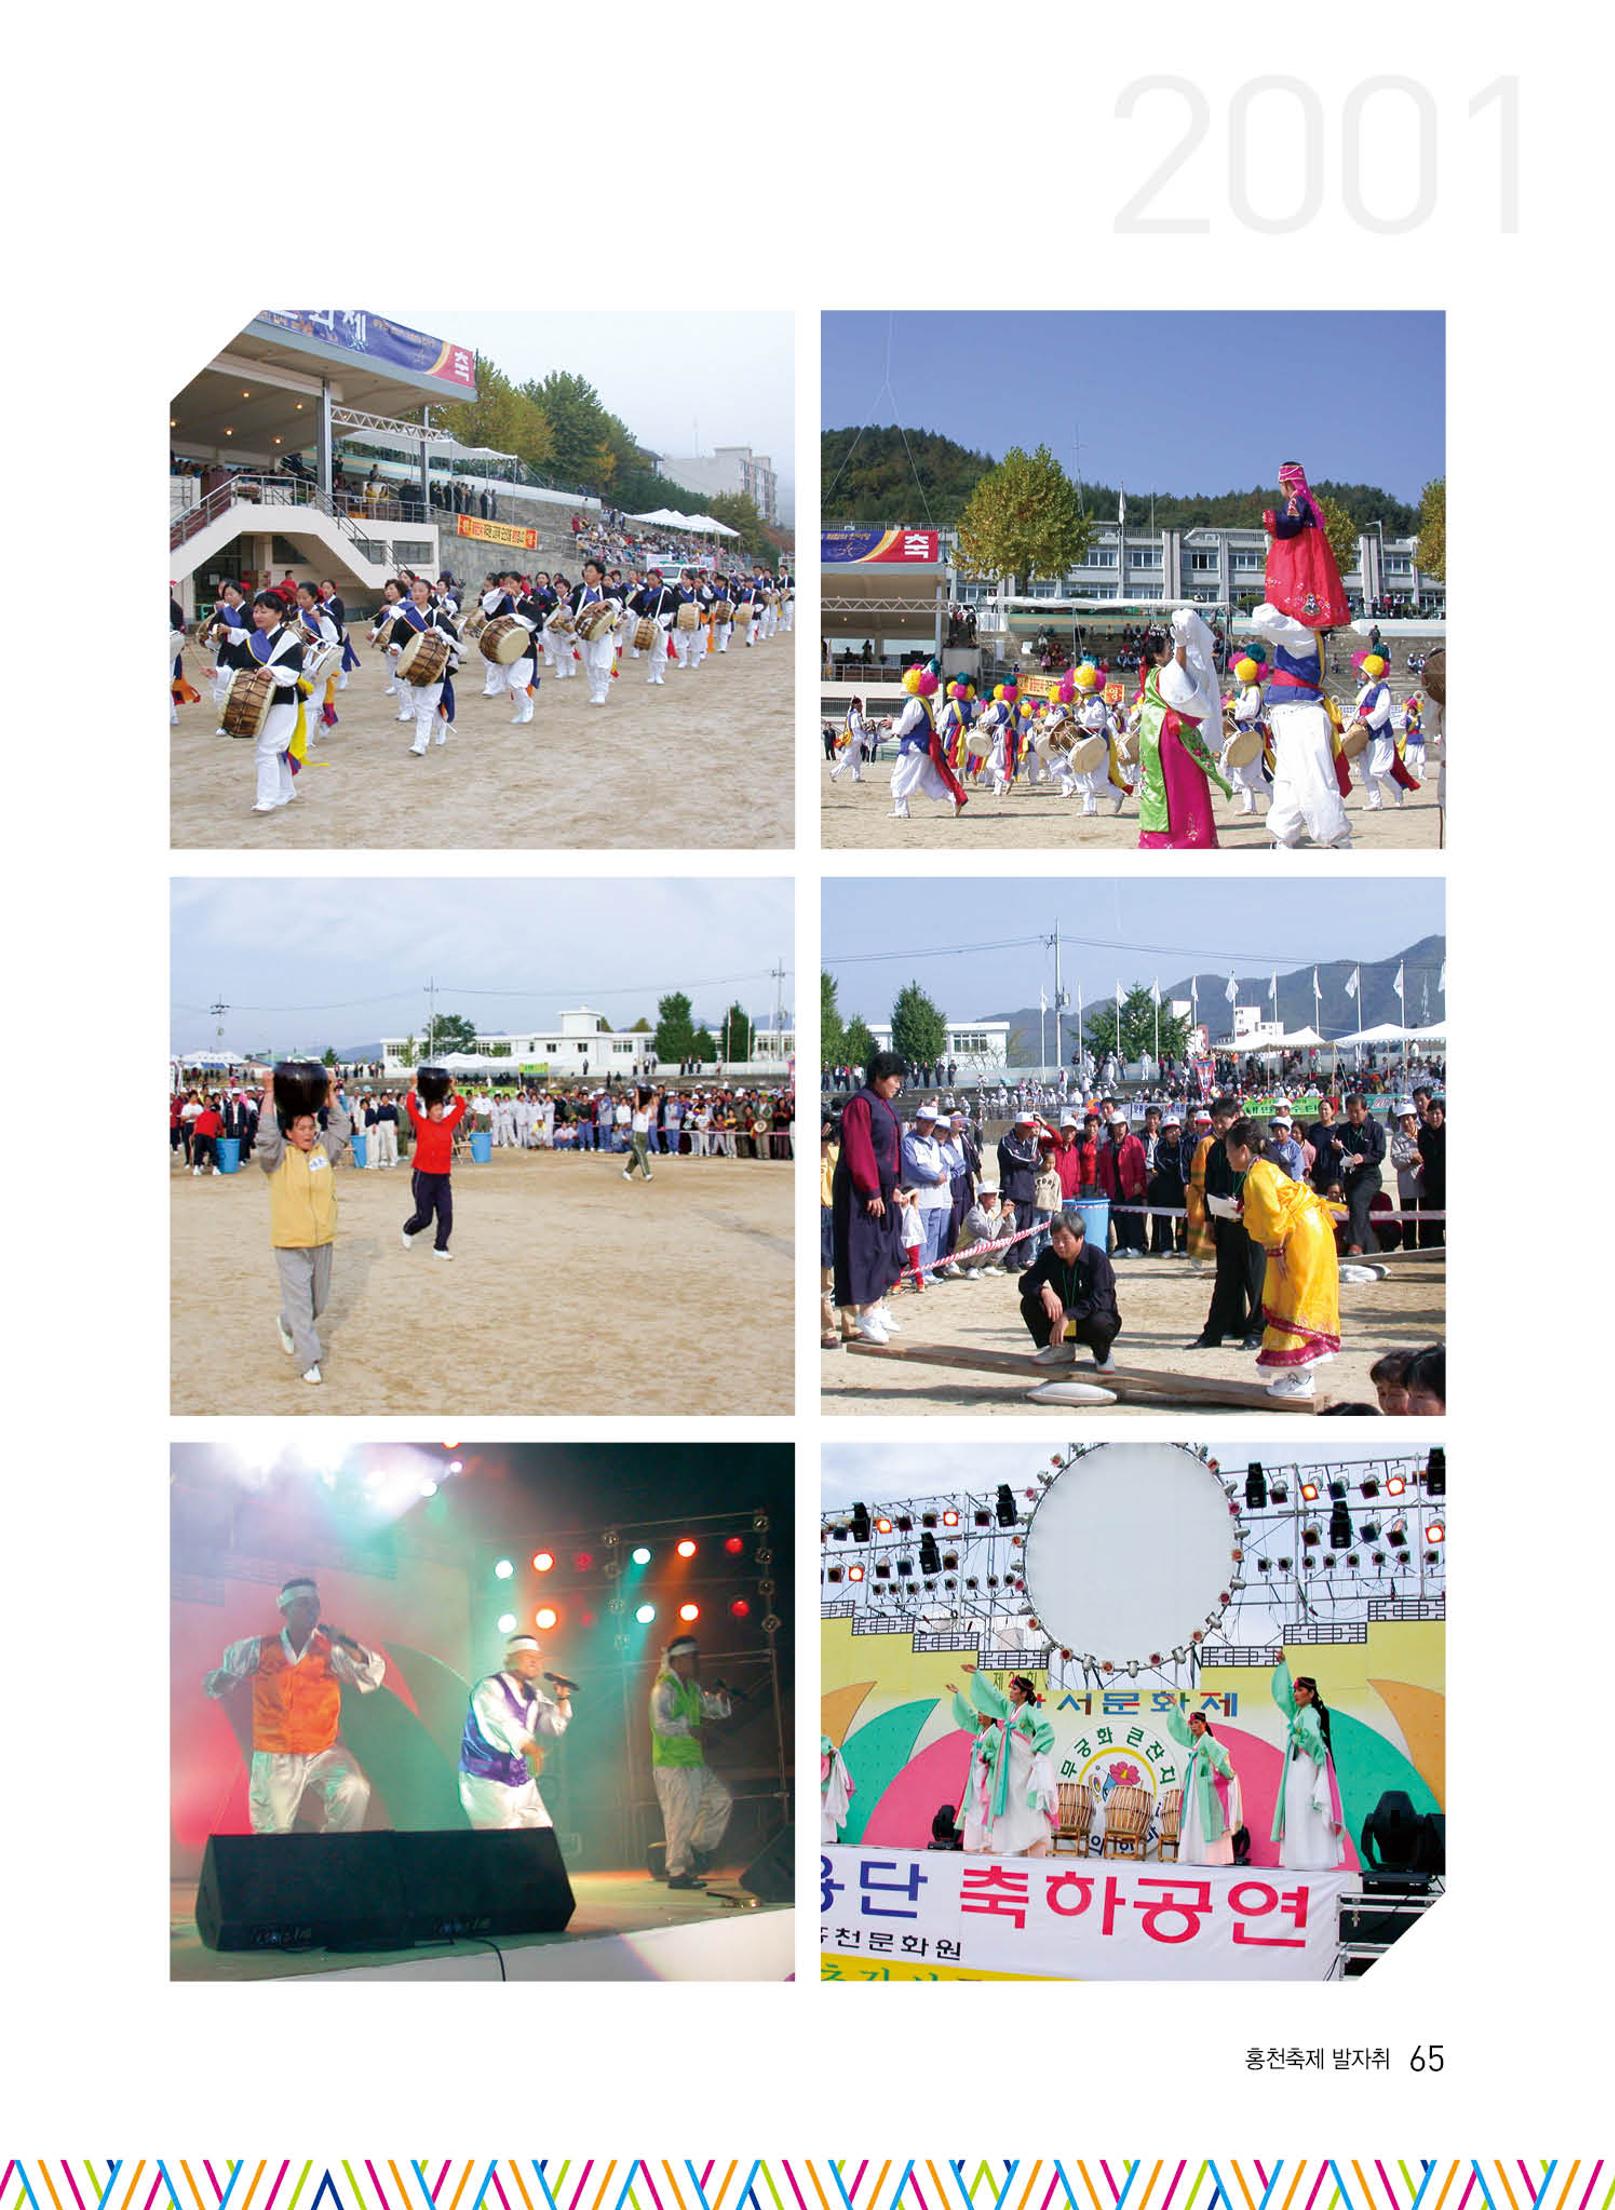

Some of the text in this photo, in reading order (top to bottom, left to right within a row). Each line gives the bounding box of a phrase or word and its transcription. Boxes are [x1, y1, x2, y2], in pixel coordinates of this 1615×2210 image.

[1113, 74, 1519, 235] 2001
[904, 533, 929, 559] 축
[1035, 1691, 1238, 1718] 서문화제
[1060, 1726, 1113, 1779] 무궁화
[960, 1865, 1310, 1948] 축하공연
[1245, 2045, 1444, 2072] 홍천축제 발자취 65
